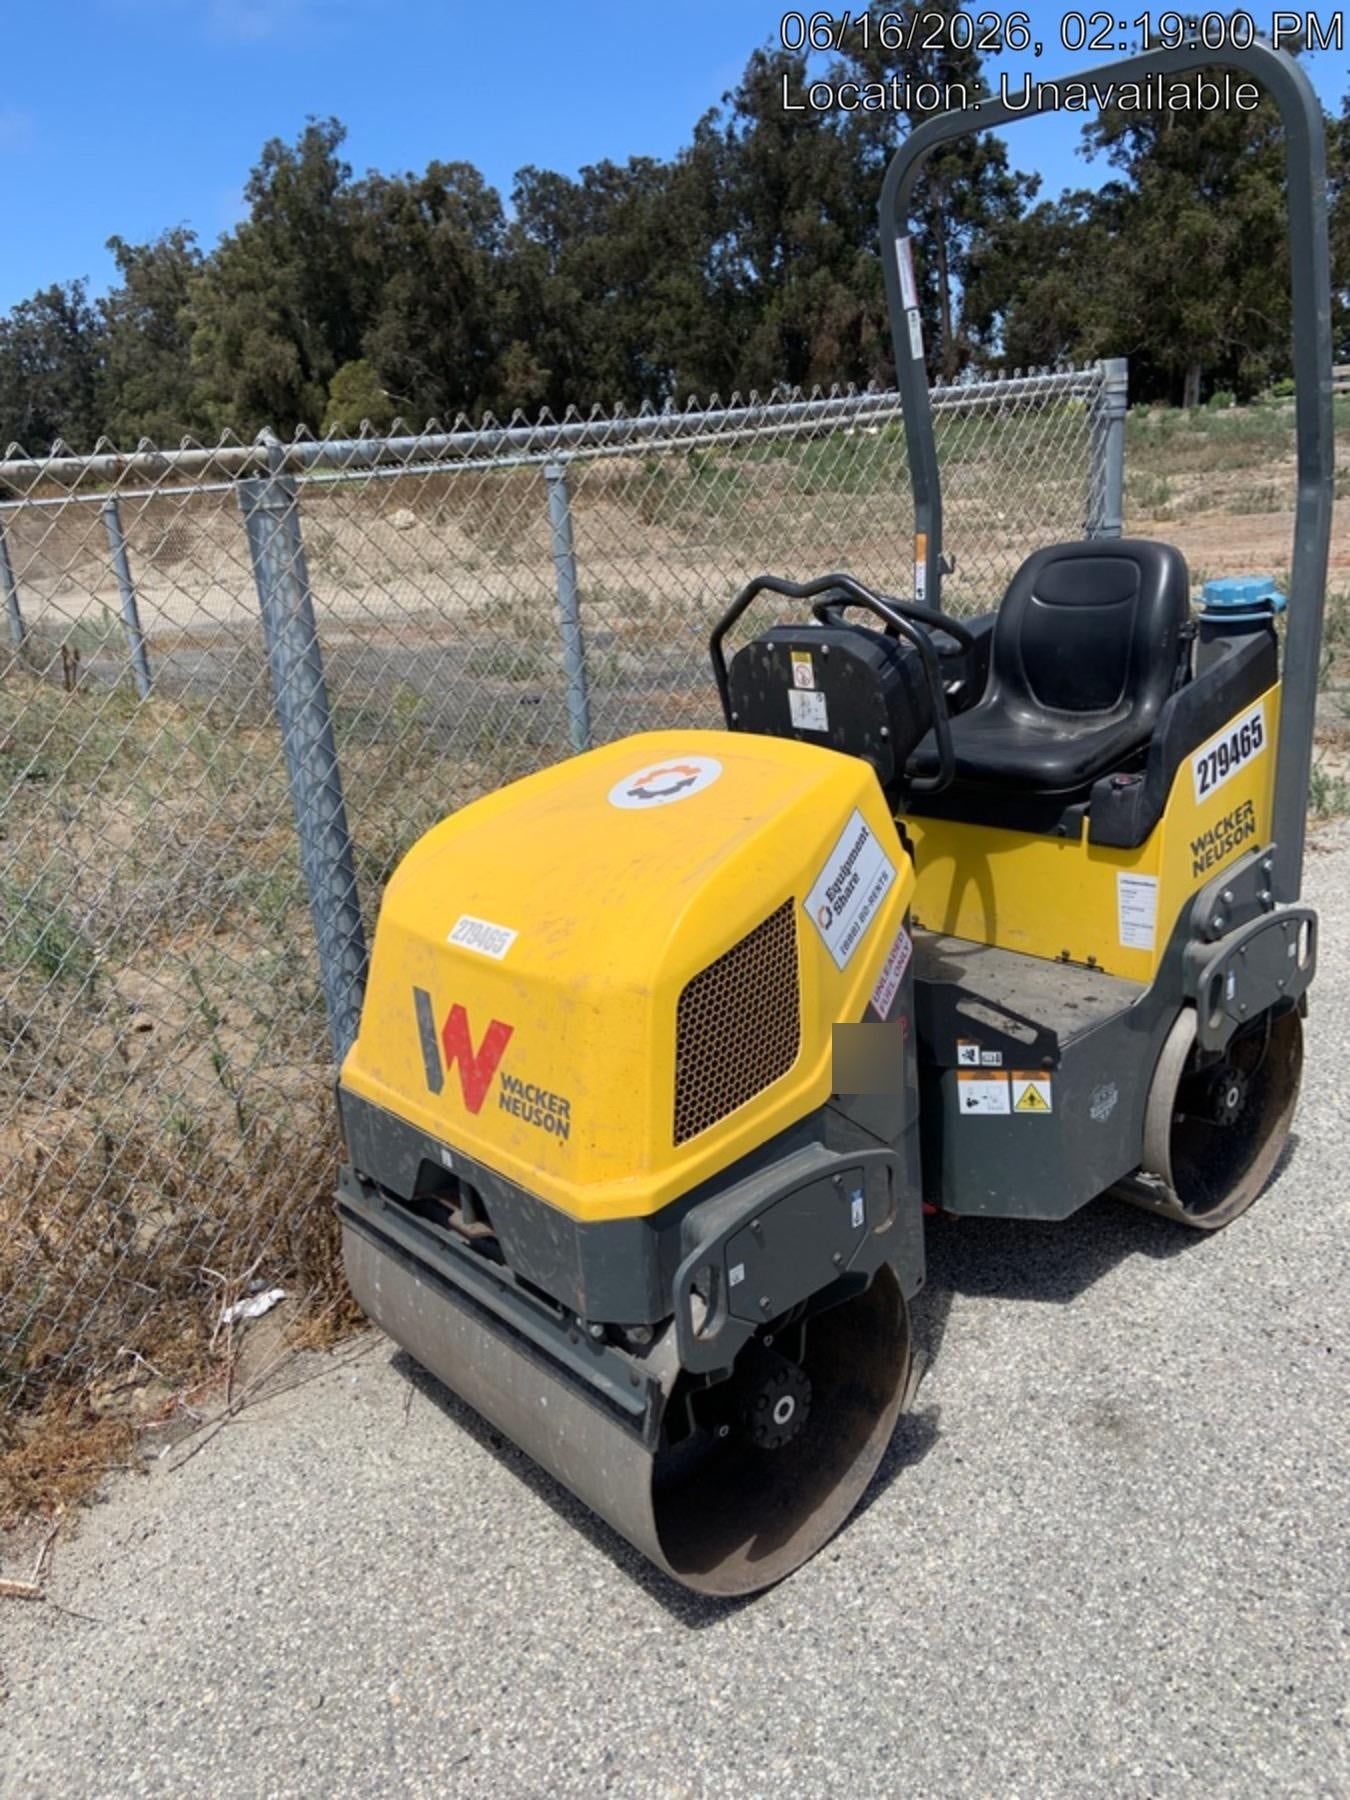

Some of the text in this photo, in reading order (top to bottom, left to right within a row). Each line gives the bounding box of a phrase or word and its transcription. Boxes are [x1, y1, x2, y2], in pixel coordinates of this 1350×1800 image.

[1196, 715, 1263, 795] 279465
[1190, 800, 1254, 857] WACKER
[1192, 819, 1256, 878] NEUSON
[825, 826, 870, 902] Equipment
[832, 872, 861, 917] Share
[450, 919, 511, 954] 279465
[498, 1093, 570, 1140] NEUSON
[500, 1072, 571, 1119] WACKER
